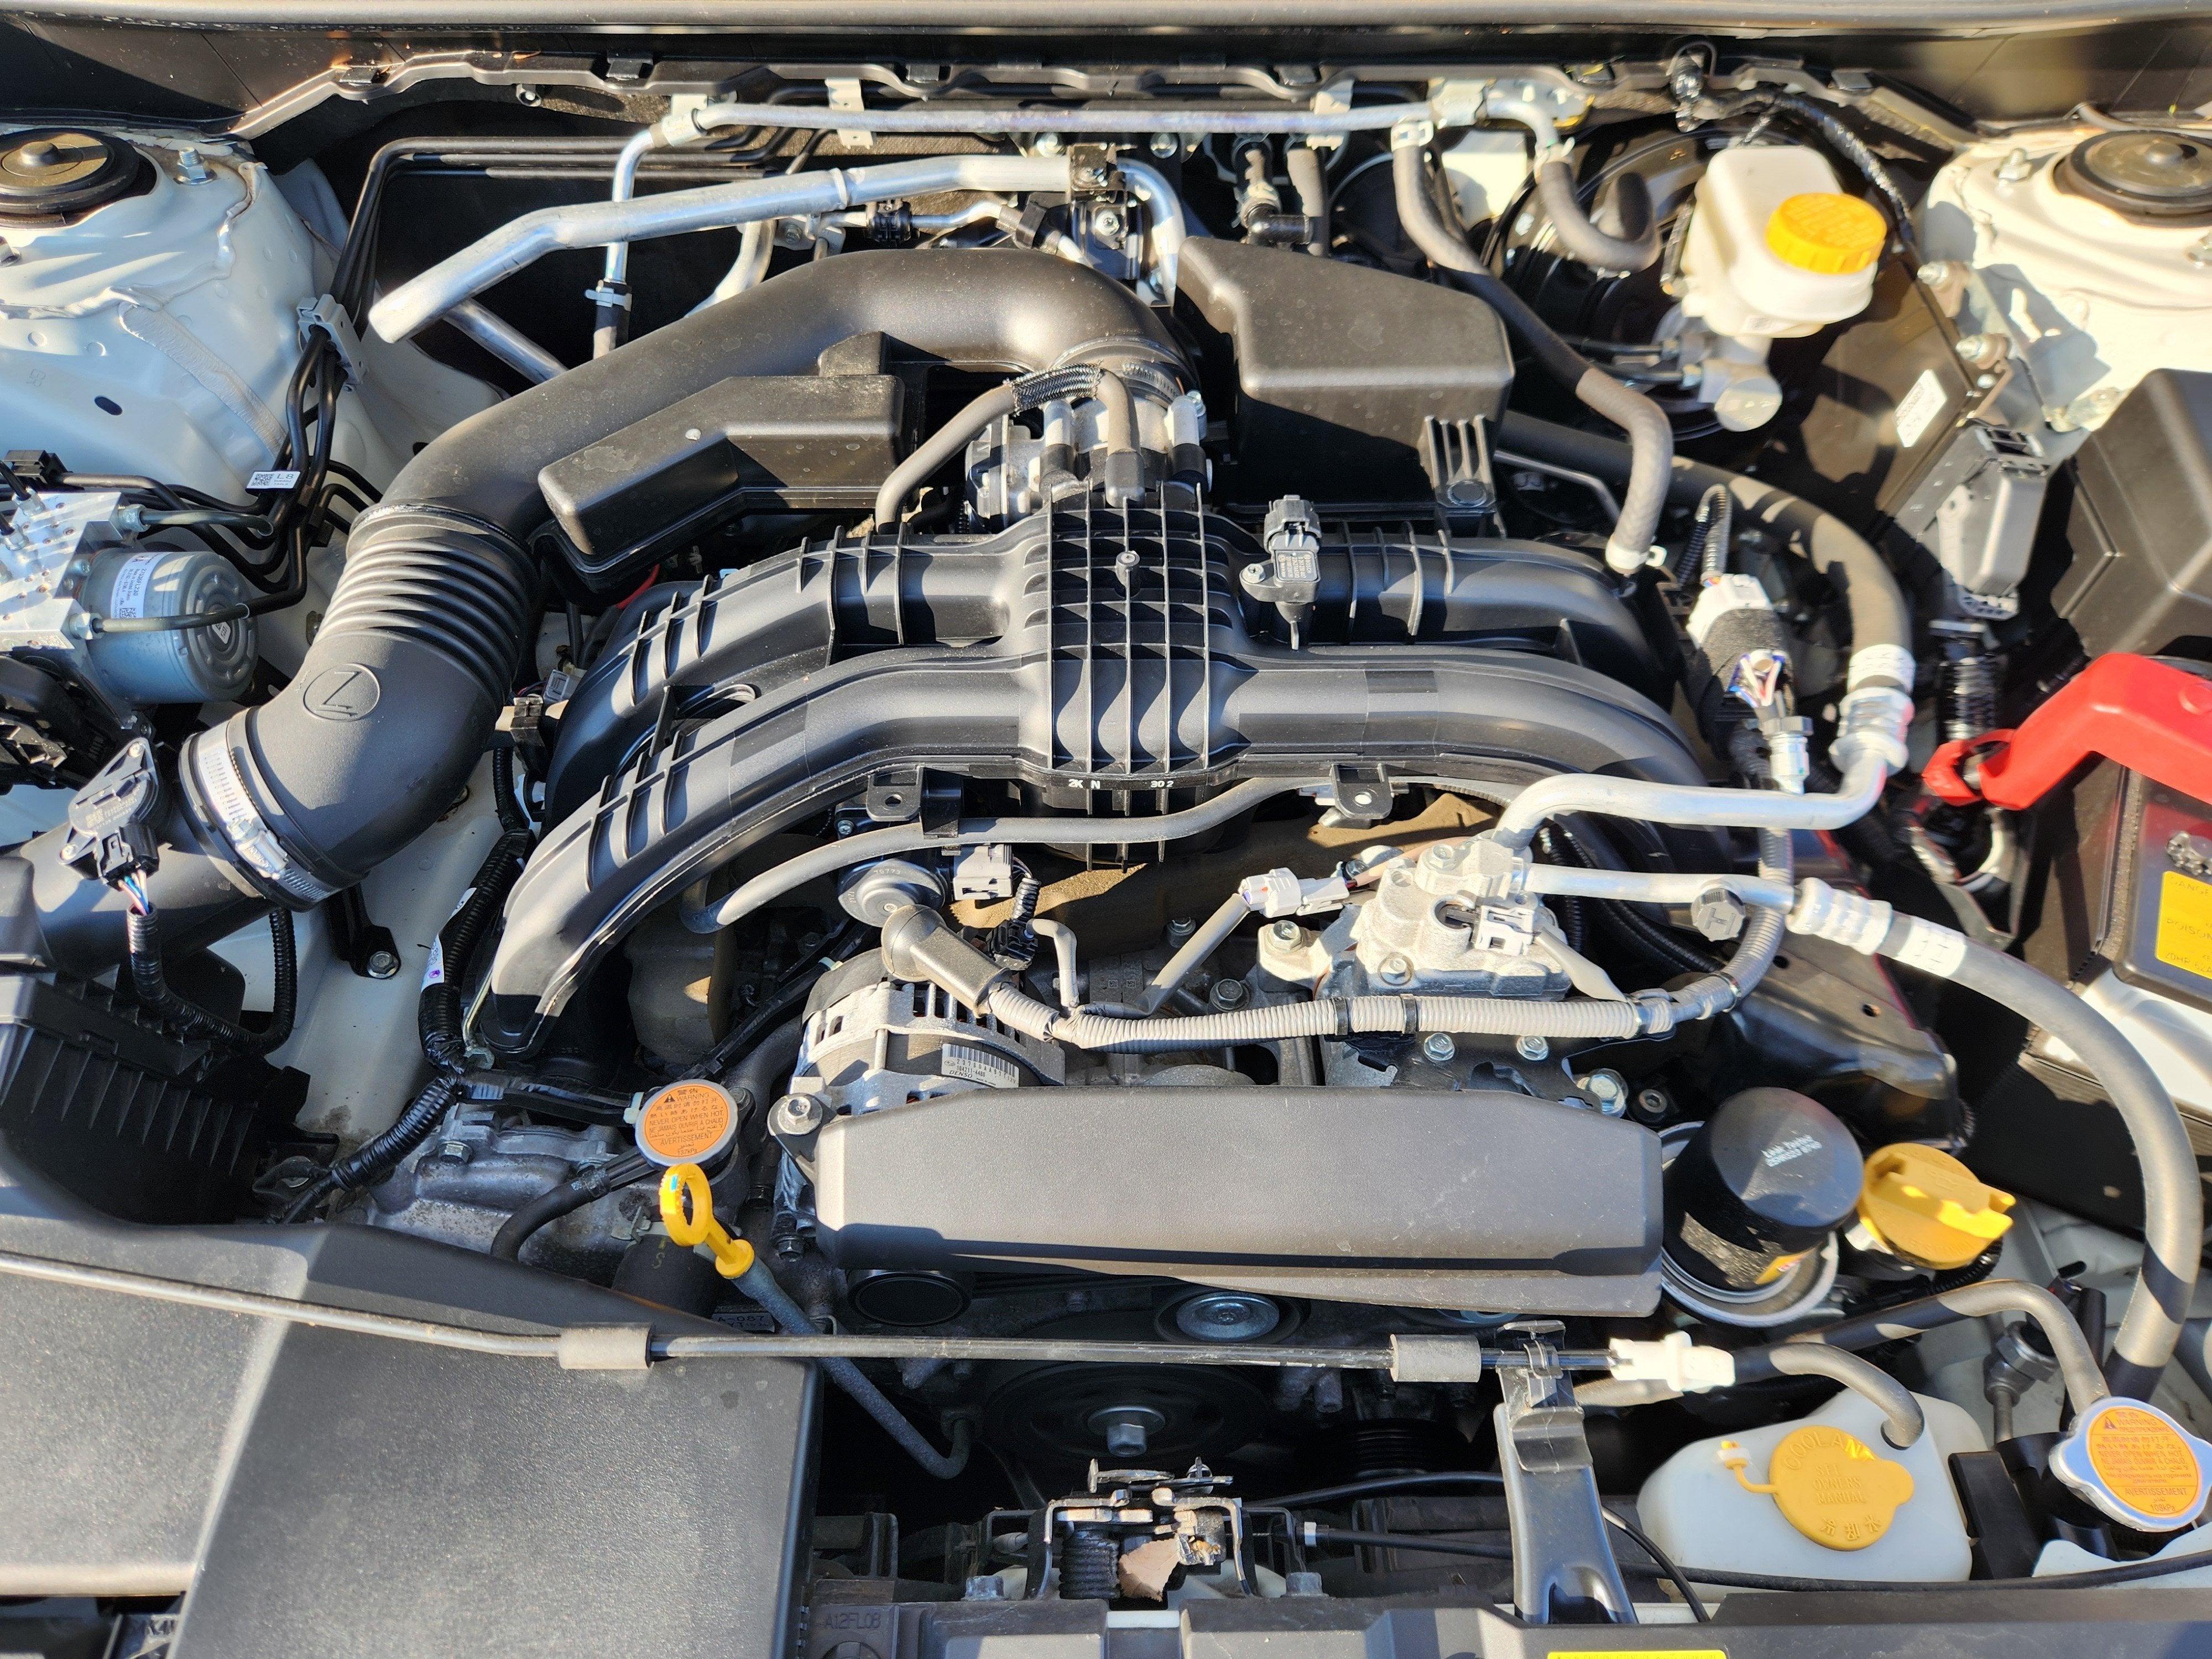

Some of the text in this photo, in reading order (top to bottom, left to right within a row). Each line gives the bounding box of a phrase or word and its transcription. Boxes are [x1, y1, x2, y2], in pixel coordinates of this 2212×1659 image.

[677, 1092, 709, 1102] WARNING
[650, 1118, 669, 1126] NEVER
[671, 1115, 688, 1123] OPEN
[658, 1124, 677, 1132] JAMAIS
[679, 1121, 698, 1129] OUVRIR
[660, 1133, 712, 1146] AVERTISSEMENT
[1814, 1490, 1868, 1505] MANUAL
[2125, 1488, 2187, 1496] AVERTISSEMENT
